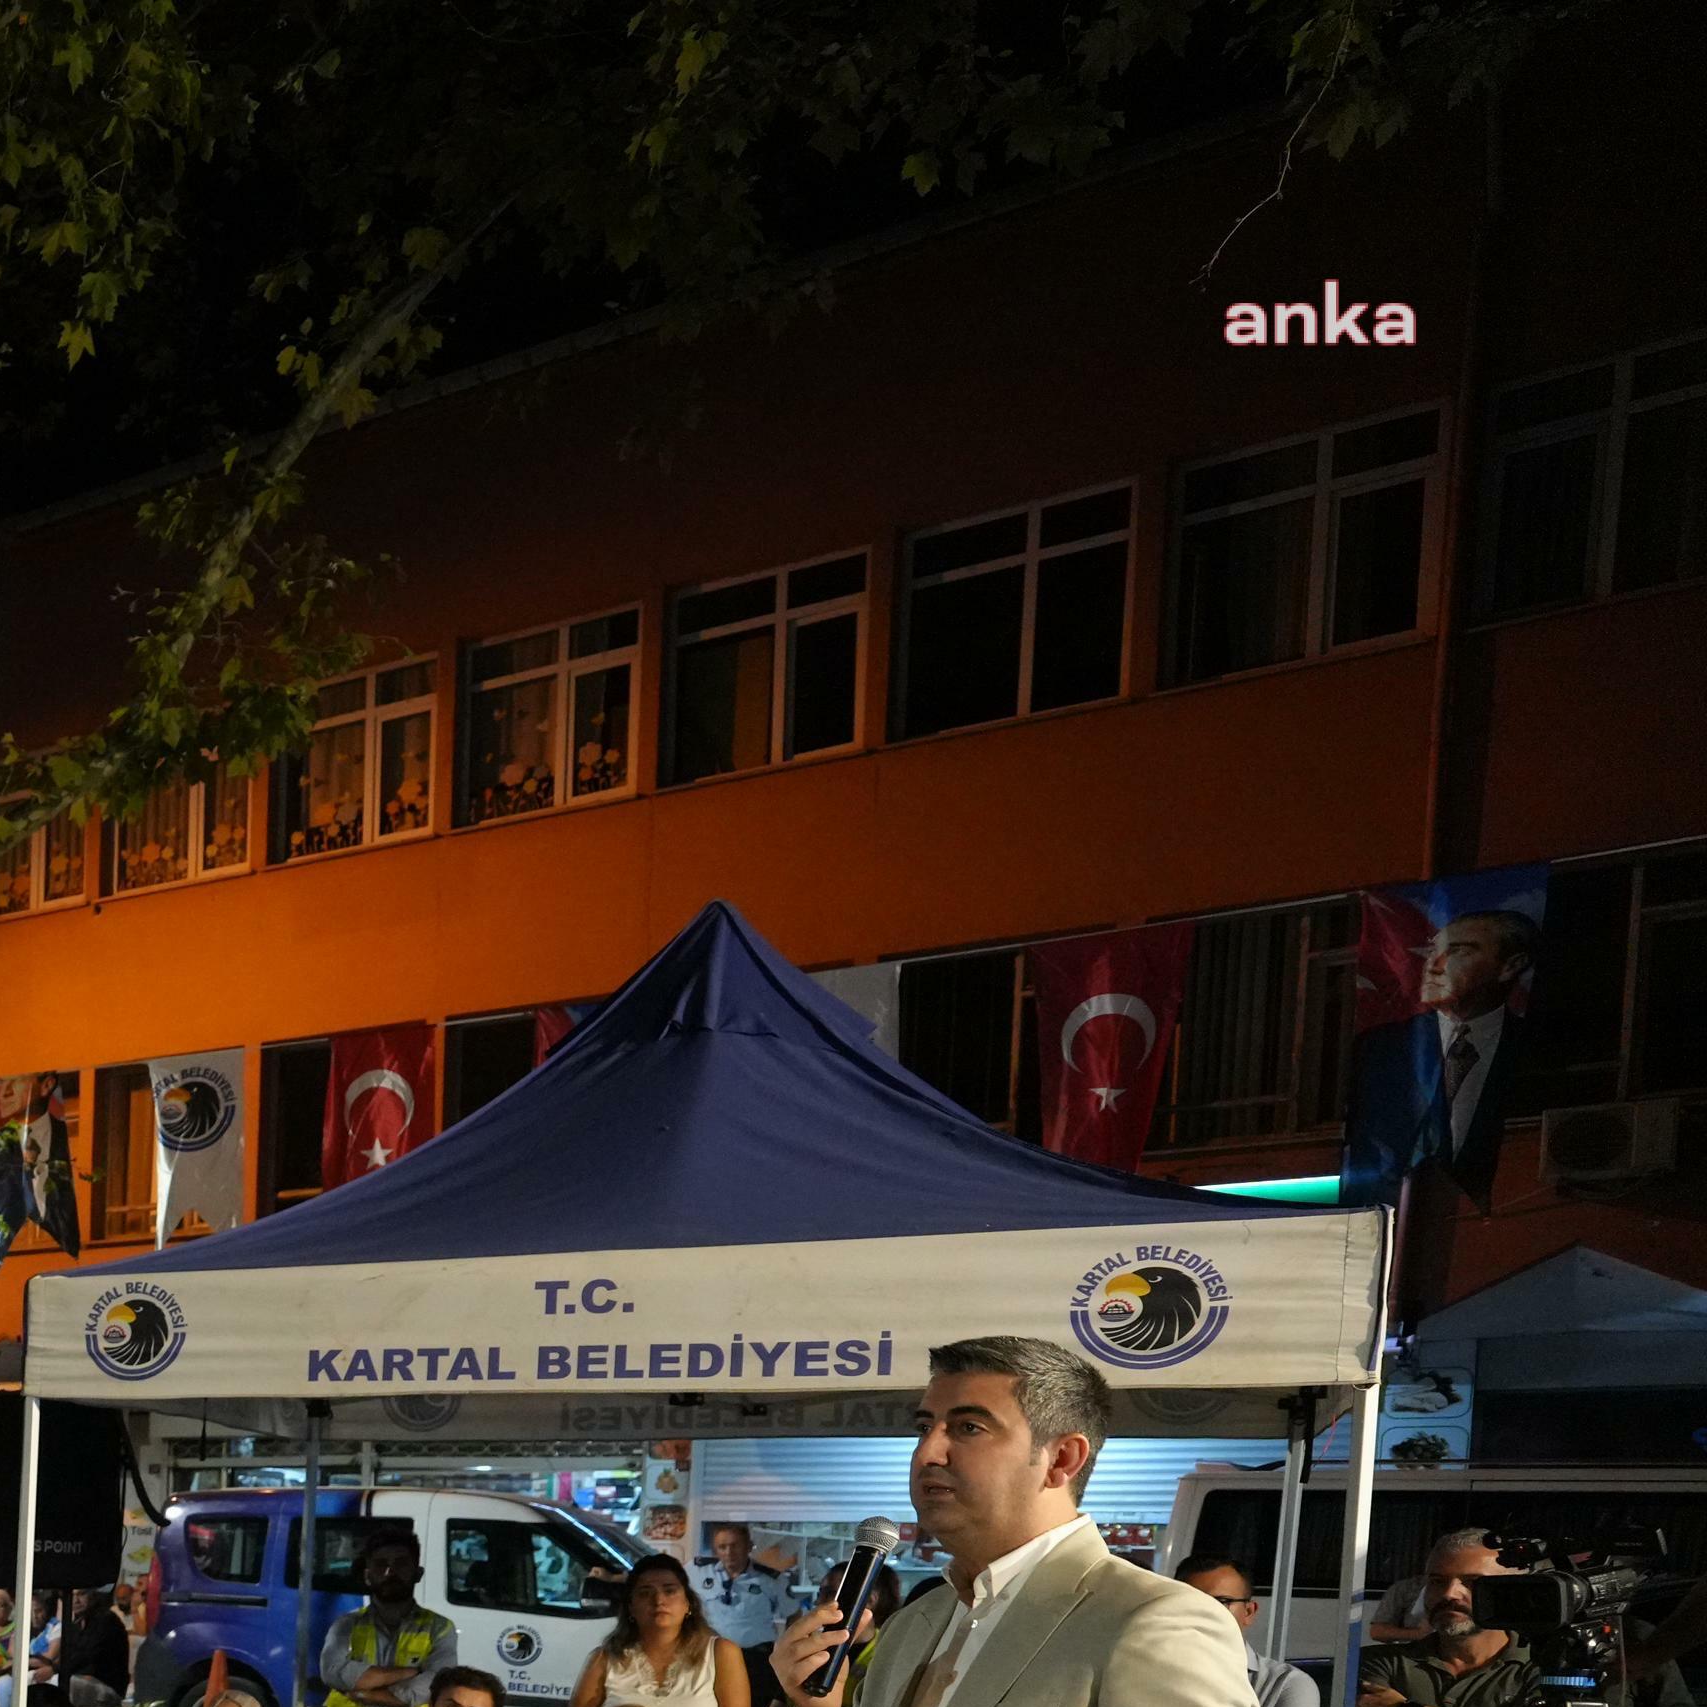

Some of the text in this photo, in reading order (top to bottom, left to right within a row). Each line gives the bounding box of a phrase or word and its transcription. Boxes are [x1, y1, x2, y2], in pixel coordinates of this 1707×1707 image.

[534, 1278, 635, 1314] T.C.
[1071, 1245, 1233, 1309] KARTAL BELEDİYESİ
[85, 1282, 188, 1332] KARTAL BELEDİYESİ
[307, 1330, 893, 1382] KARTAL BELEDİYESİ
[43, 1540, 84, 1555] POINT
[508, 1681, 572, 1697] BELEDİYE
